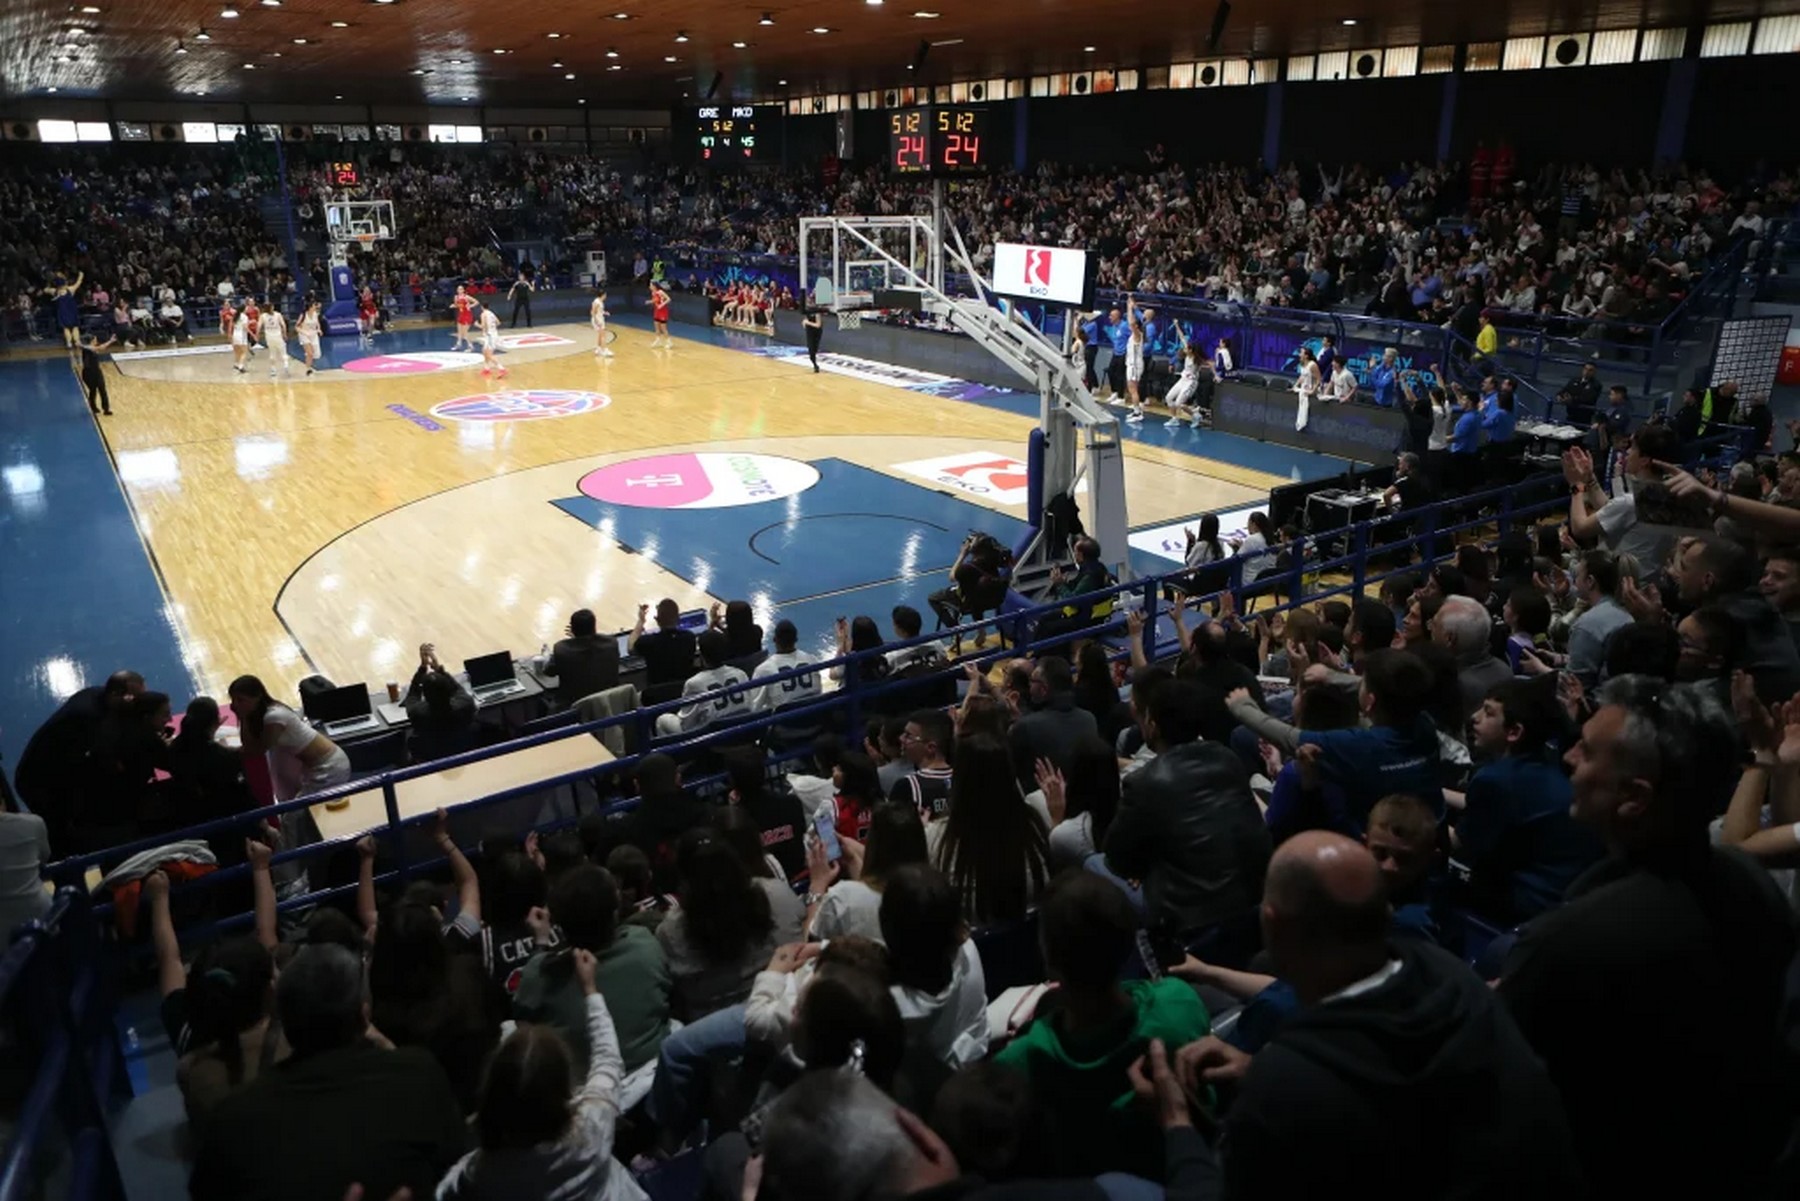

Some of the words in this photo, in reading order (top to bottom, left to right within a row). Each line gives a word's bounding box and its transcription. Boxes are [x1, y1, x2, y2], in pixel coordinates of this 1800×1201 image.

[699, 107, 719, 118] GRE
[732, 107, 753, 117] MKD
[741, 136, 754, 147] 45
[944, 134, 979, 164] 24
[897, 136, 925, 166] 24
[338, 171, 356, 184] 24
[937, 476, 991, 494] EKO
